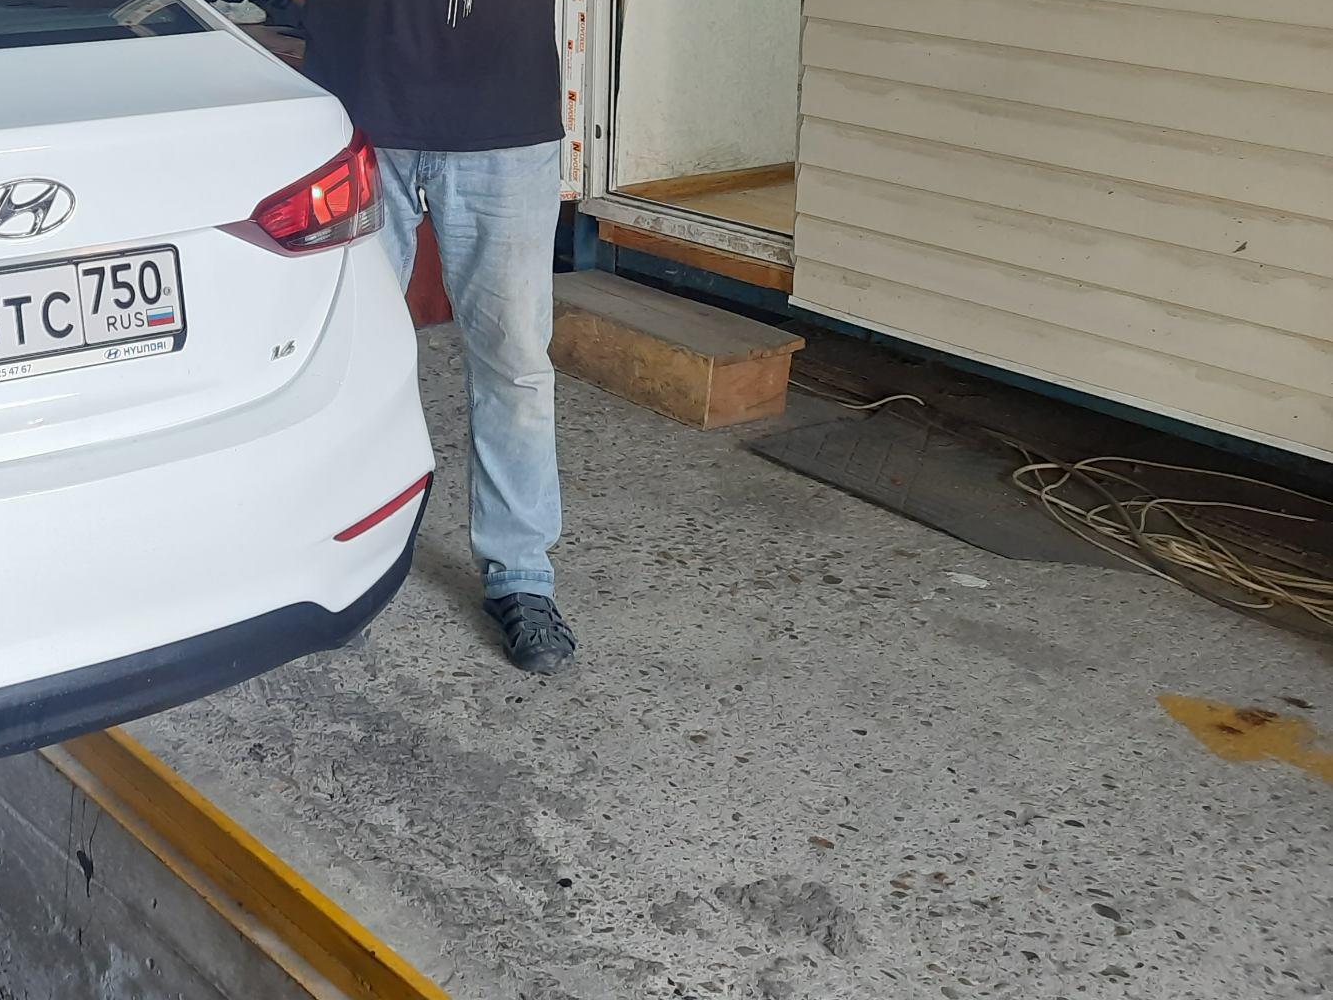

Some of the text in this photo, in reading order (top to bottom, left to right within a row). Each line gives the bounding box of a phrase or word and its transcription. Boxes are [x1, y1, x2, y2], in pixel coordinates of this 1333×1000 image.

[567, 90, 578, 133] Novotex
[570, 141, 581, 184] Novotex
[82, 260, 162, 316] 750
[107, 311, 145, 333] RUS
[123, 340, 167, 356] HYUNDAI
[8, 366, 19, 376] 47
[21, 364, 32, 374] 67
